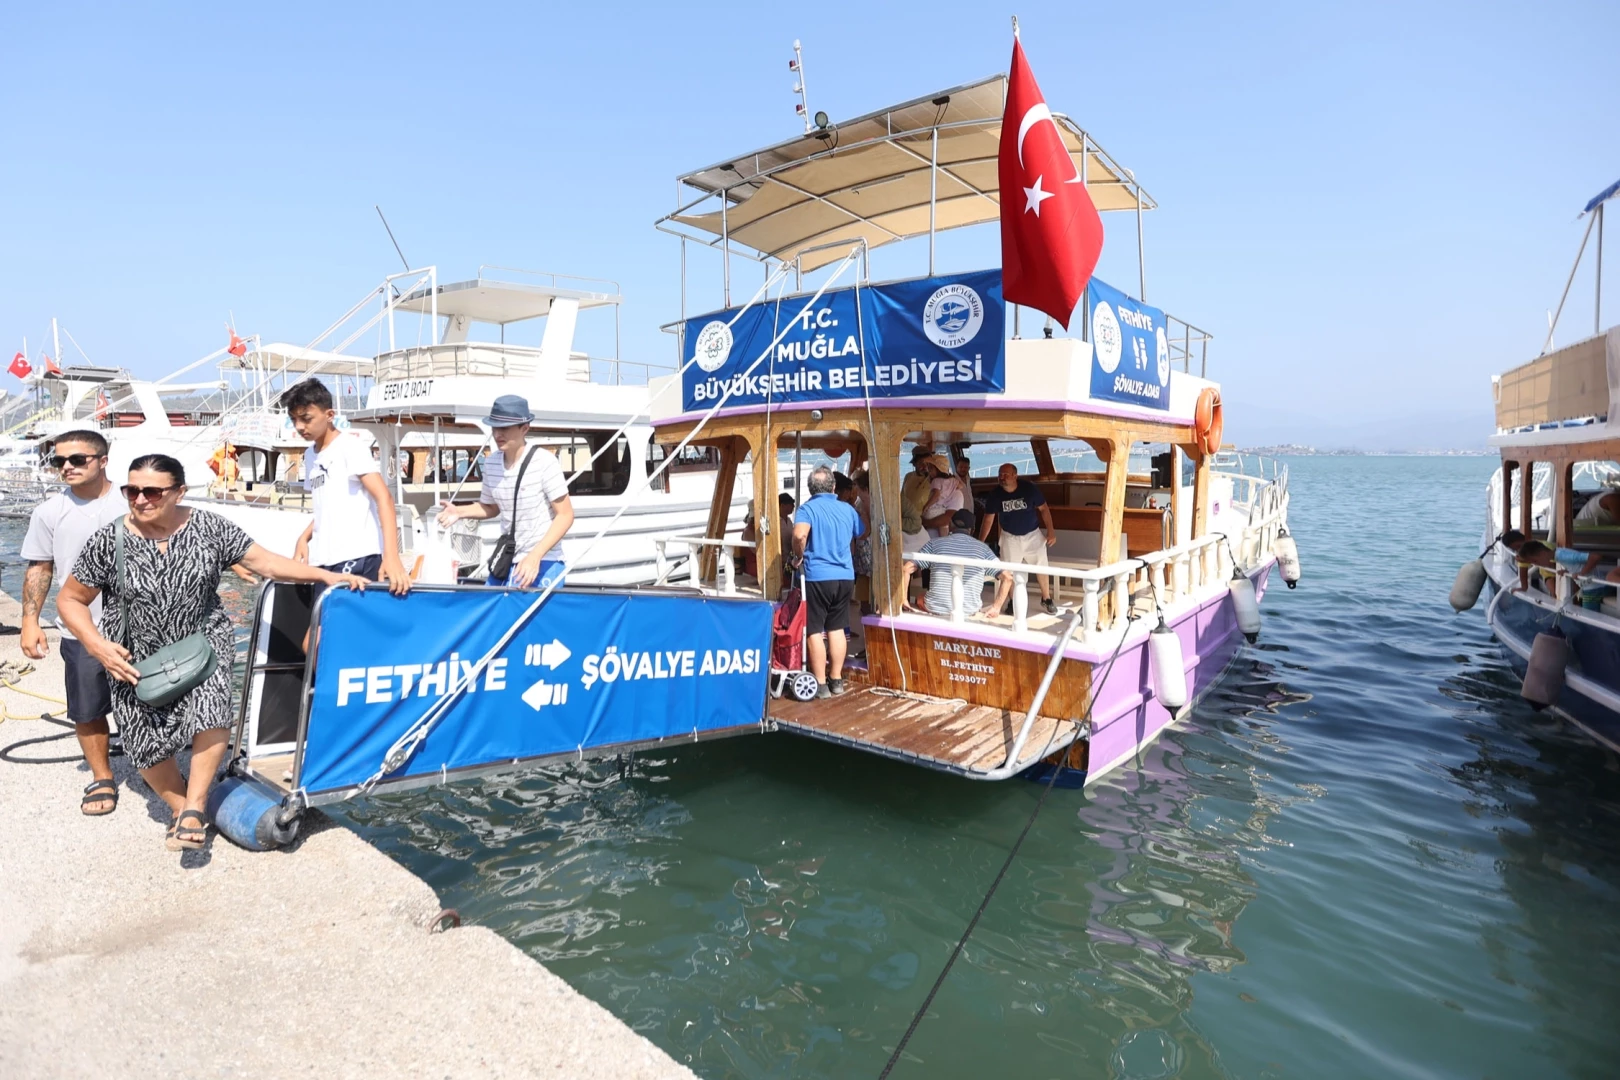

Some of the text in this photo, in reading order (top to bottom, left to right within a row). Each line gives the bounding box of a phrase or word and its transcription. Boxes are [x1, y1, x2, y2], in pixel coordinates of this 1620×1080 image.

[800, 308, 838, 331] T.C.
[1118, 305, 1153, 332] FETHİYE
[777, 333, 860, 363] MUĞLA
[384, 379, 434, 401] EFEM 2 BOAT
[694, 353, 982, 401] BÜYÜKŞEHİR BELEDİYESİ
[1113, 373, 1143, 396] ŞÖVALYE
[336, 652, 508, 707] FETHİYE
[580, 646, 761, 691] ŞÖVALYE ADASI
[949, 673, 987, 685] 2293077
